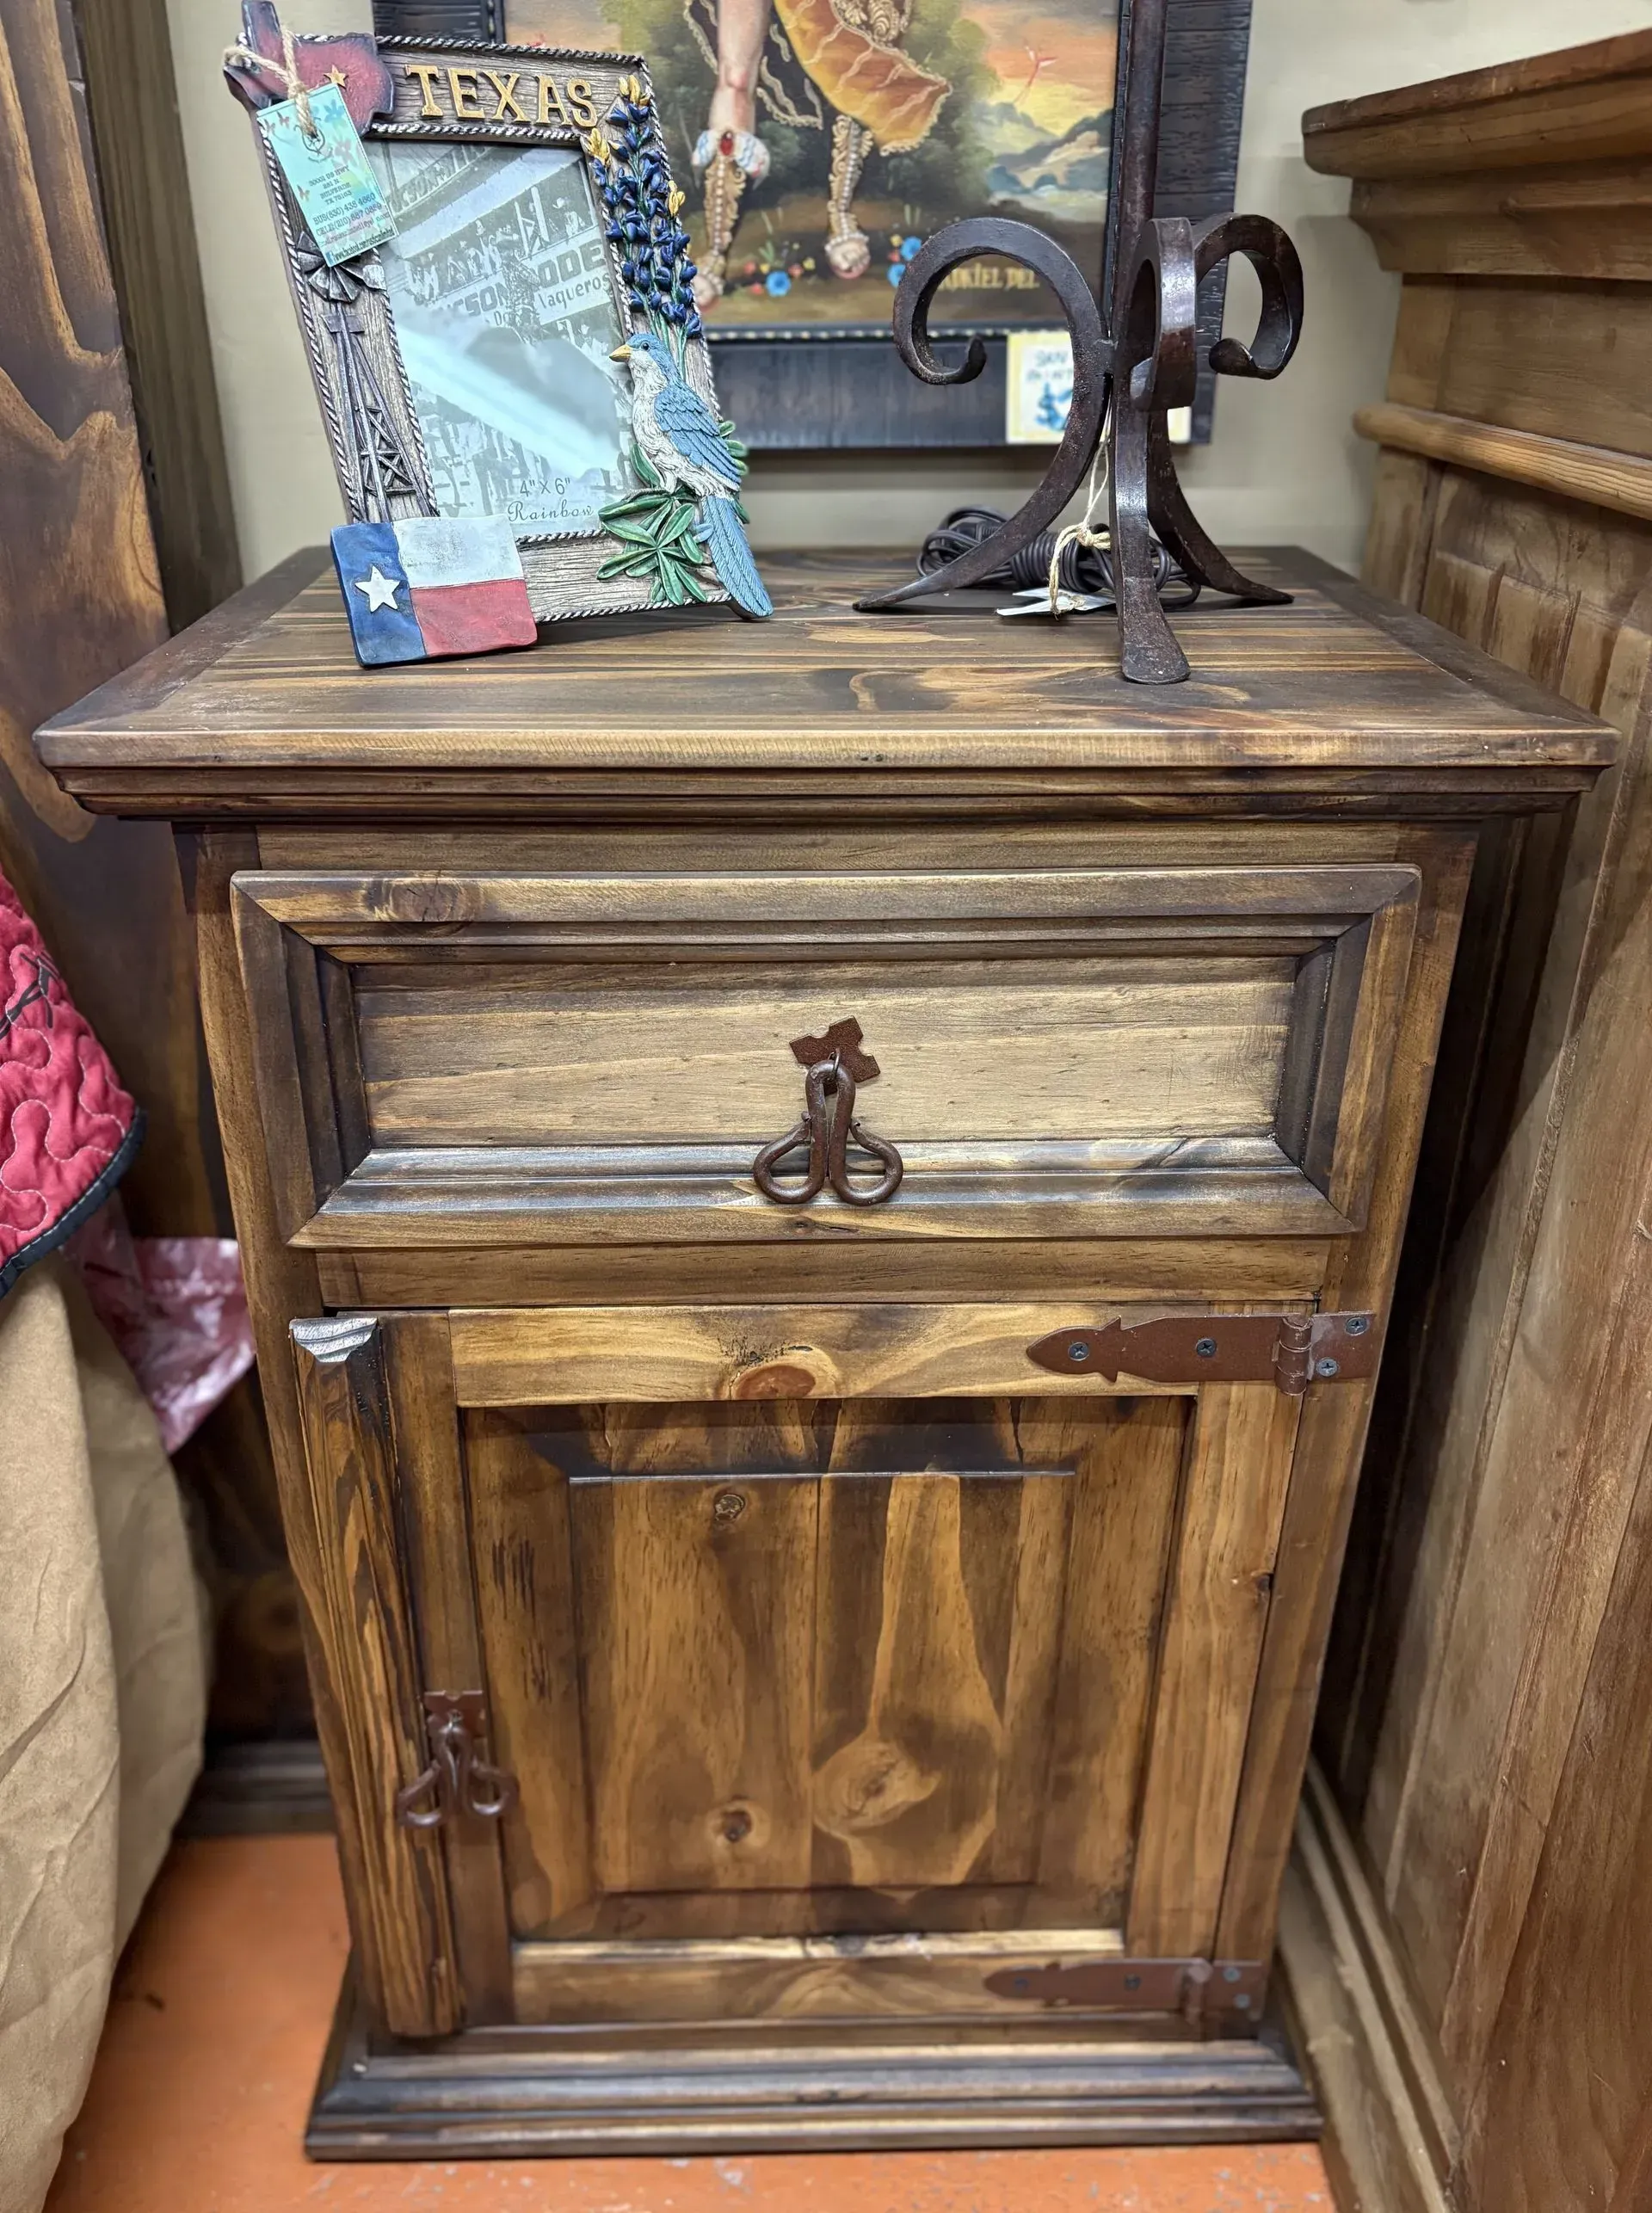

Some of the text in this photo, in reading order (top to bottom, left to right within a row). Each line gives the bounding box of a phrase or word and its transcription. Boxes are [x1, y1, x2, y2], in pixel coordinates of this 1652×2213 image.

[405, 64, 598, 127] TEXAS
[555, 478, 570, 495] 6"
[508, 499, 594, 521] Rainbow
